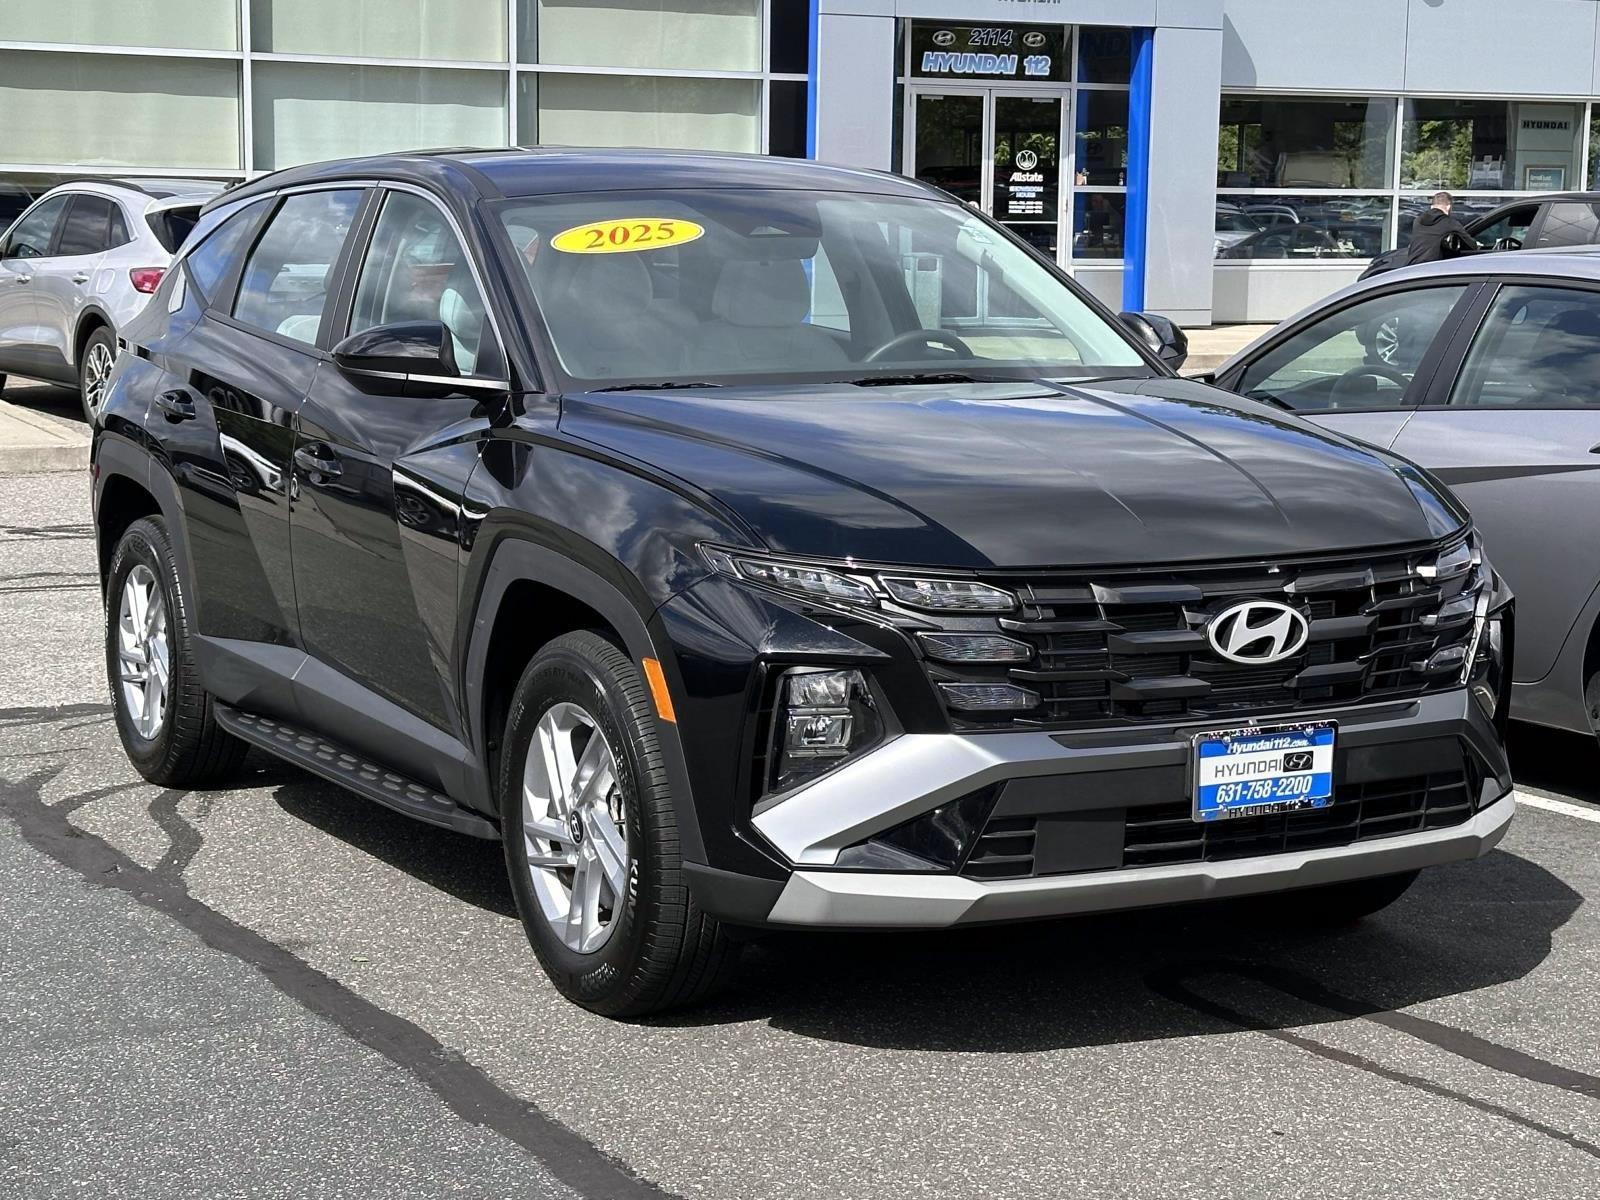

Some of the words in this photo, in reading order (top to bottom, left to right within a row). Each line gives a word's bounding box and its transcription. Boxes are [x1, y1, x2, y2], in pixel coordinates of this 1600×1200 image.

[968, 28, 1014, 46] 2114
[921, 51, 1018, 75] HYUNDAI
[1023, 55, 1051, 76] 112
[1522, 121, 1568, 130] HYUNDAI
[1009, 171, 1044, 182] Allstate
[585, 222, 675, 249] 2025
[1215, 758, 1282, 778] HYUNDAI
[1216, 776, 1312, 803] 631-758-2200
